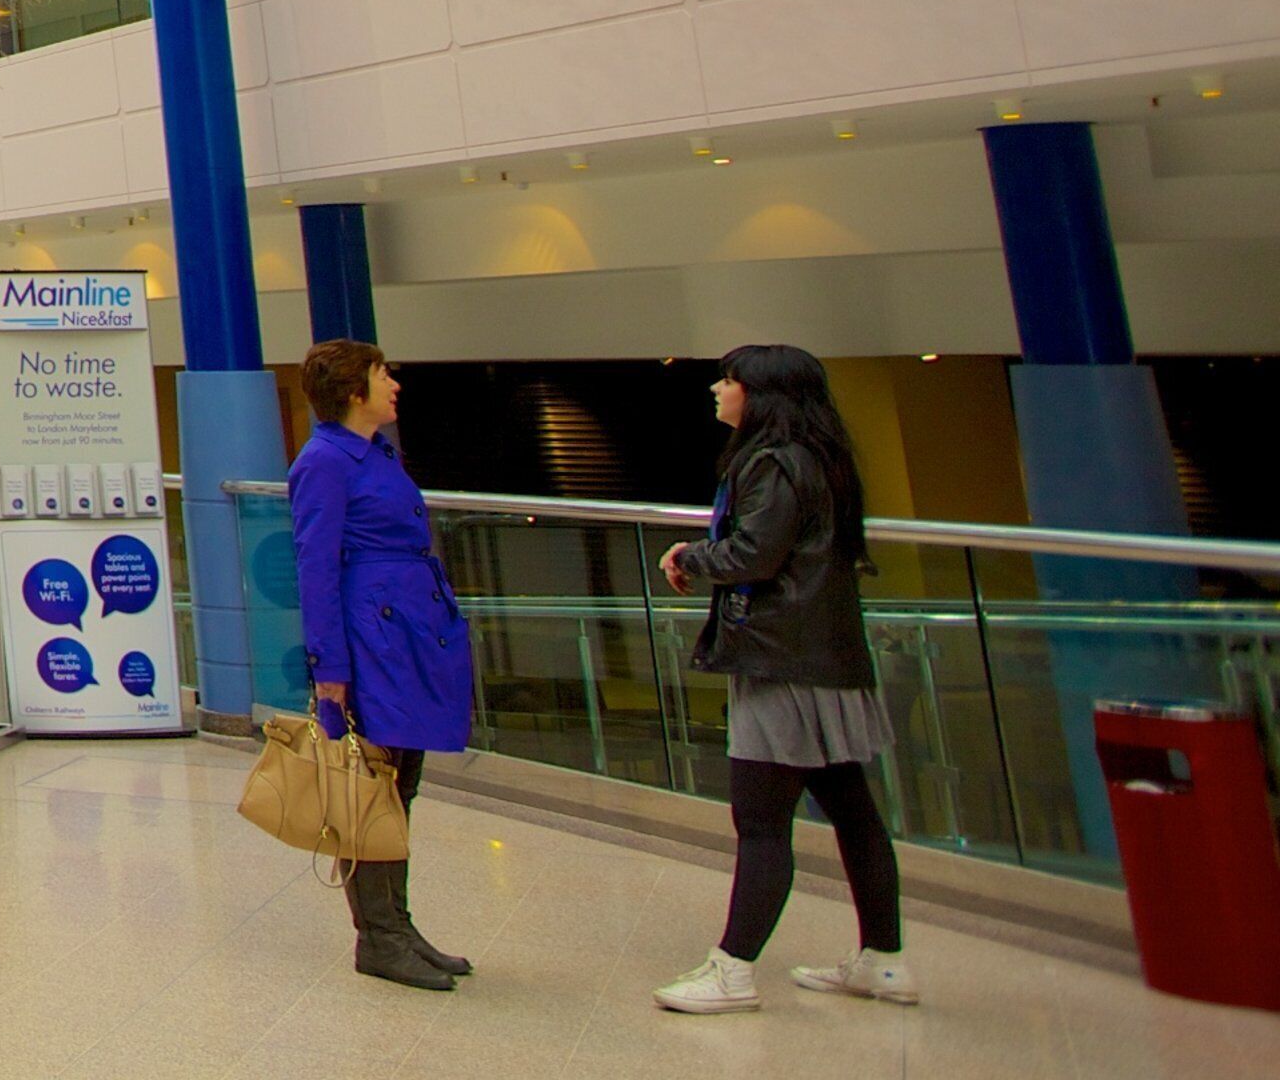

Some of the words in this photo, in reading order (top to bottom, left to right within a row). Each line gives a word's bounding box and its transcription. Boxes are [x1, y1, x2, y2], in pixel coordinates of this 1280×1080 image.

[3, 277, 132, 307] Mainline
[61, 310, 133, 327] Nice&fast
[20, 351, 56, 375] No
[64, 351, 116, 374] time
[14, 378, 38, 398] to
[46, 377, 123, 398] waste.
[23, 412, 72, 422] Birmingham
[73, 412, 95, 421] Moor
[97, 411, 121, 421] Street
[27, 424, 36, 433] to
[37, 424, 67, 433] London
[70, 423, 118, 435] Marylebone
[41, 436, 61, 445] from
[62, 436, 77, 447] just
[78, 436, 90, 445] 90
[106, 552, 142, 563] Spacious
[105, 563, 129, 572] tables
[130, 563, 146, 572] and
[101, 574, 127, 584] power
[127, 573, 151, 584] points
[43, 579, 69, 590] Free
[101, 583, 111, 593] at
[112, 584, 133, 594] every
[39, 591, 74, 602] Wi-Fi.
[48, 662, 81, 672] flexible
